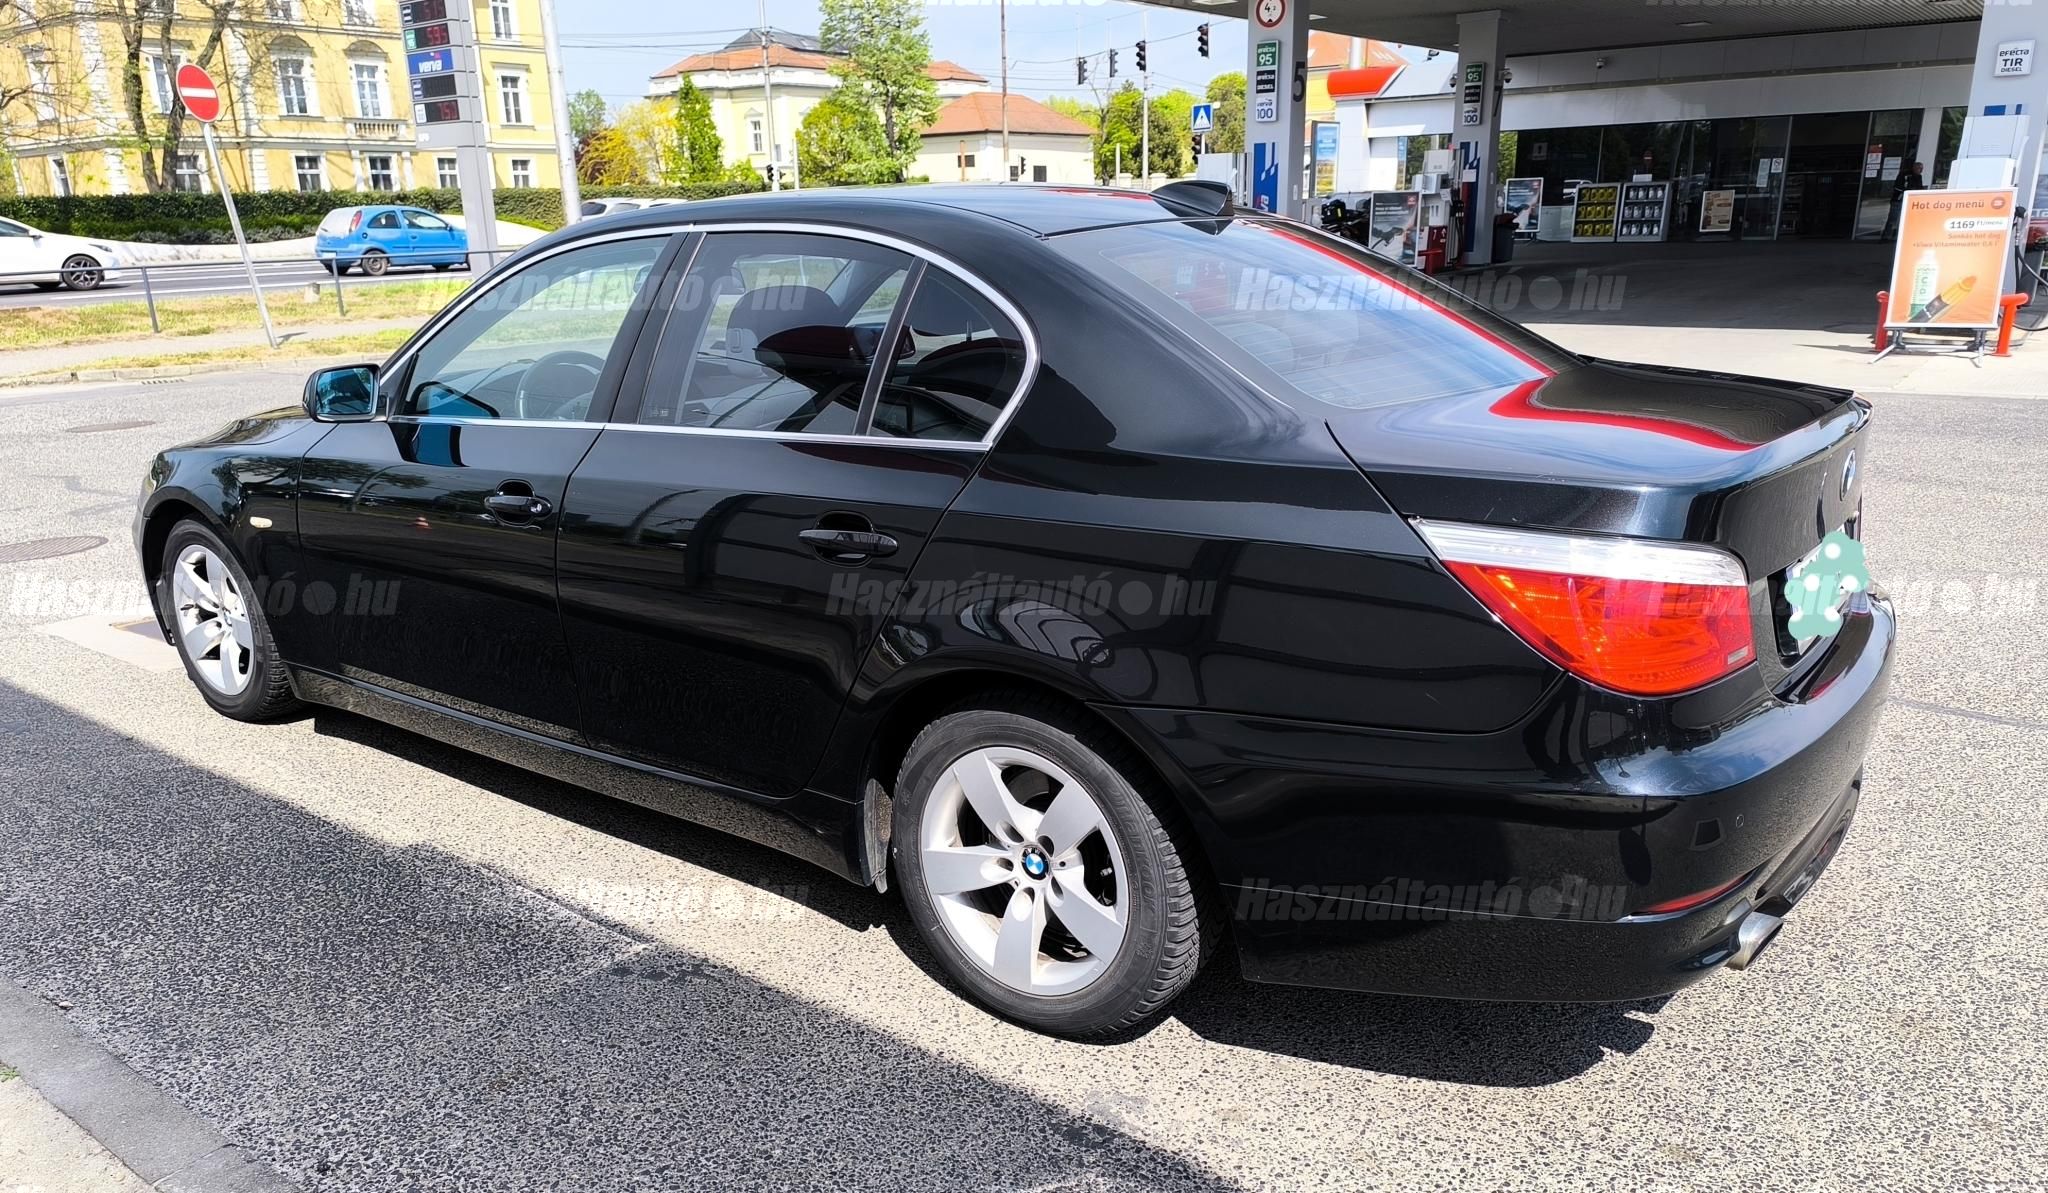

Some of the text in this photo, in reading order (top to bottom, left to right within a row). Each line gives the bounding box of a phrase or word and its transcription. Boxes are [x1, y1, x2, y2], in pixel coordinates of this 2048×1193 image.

[1259, 54, 1273, 66] 95
[2002, 57, 2024, 67] TIR
[1292, 61, 1306, 103] 5
[1467, 72, 1480, 82] 95
[1256, 108, 1274, 120] 100
[1911, 200, 1930, 210] Hot
[1932, 200, 1952, 211] dog
[1954, 200, 1985, 209] menü
[1949, 220, 1975, 230] 1169
